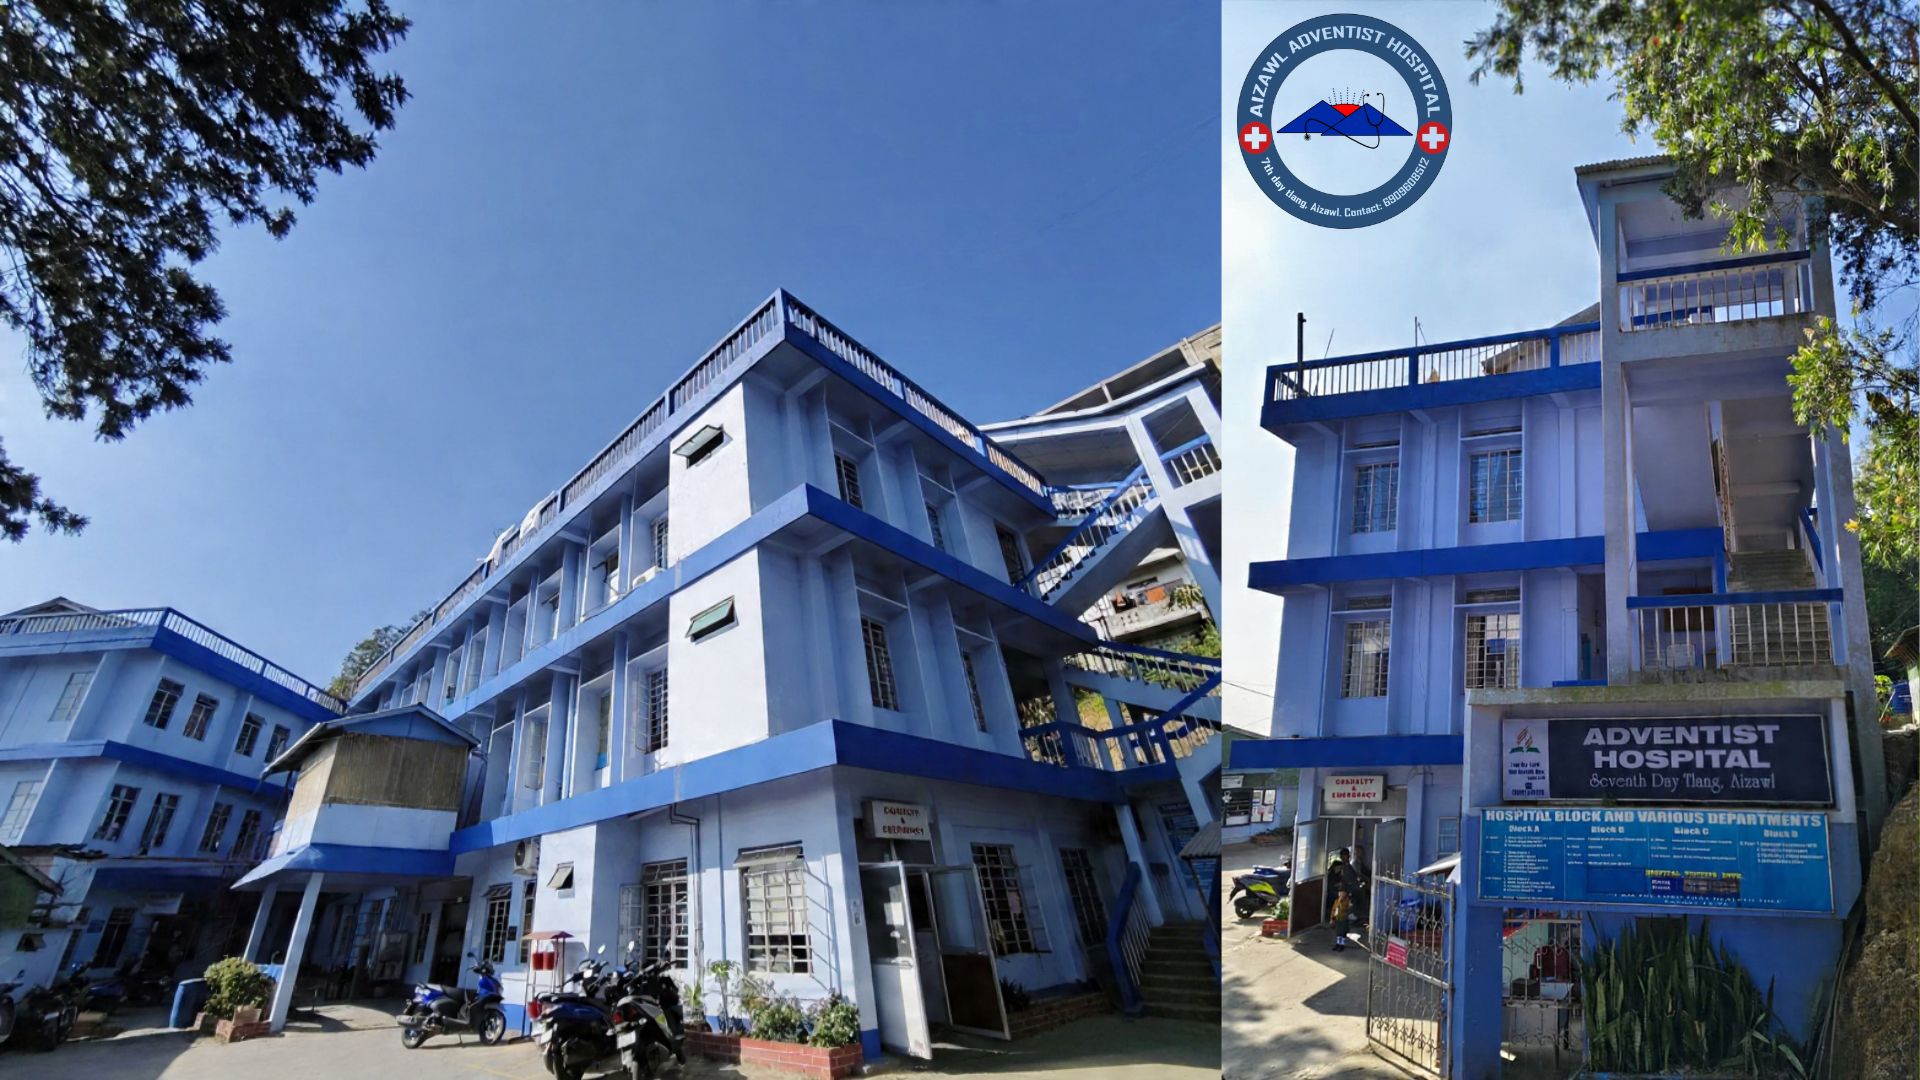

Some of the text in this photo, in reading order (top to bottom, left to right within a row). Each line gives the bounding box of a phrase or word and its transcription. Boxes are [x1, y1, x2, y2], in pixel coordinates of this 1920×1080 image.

[1583, 725, 1780, 746] ADVENTIST
[1594, 749, 1771, 769] HOSPITAL
[1590, 773, 1647, 788] Seventh
[1651, 773, 1680, 793] Day
[1730, 773, 1776, 789] Aizawl
[1486, 810, 1822, 827] HOSPITAL BLOCK AND VARIOUS DEPARTMENTS
